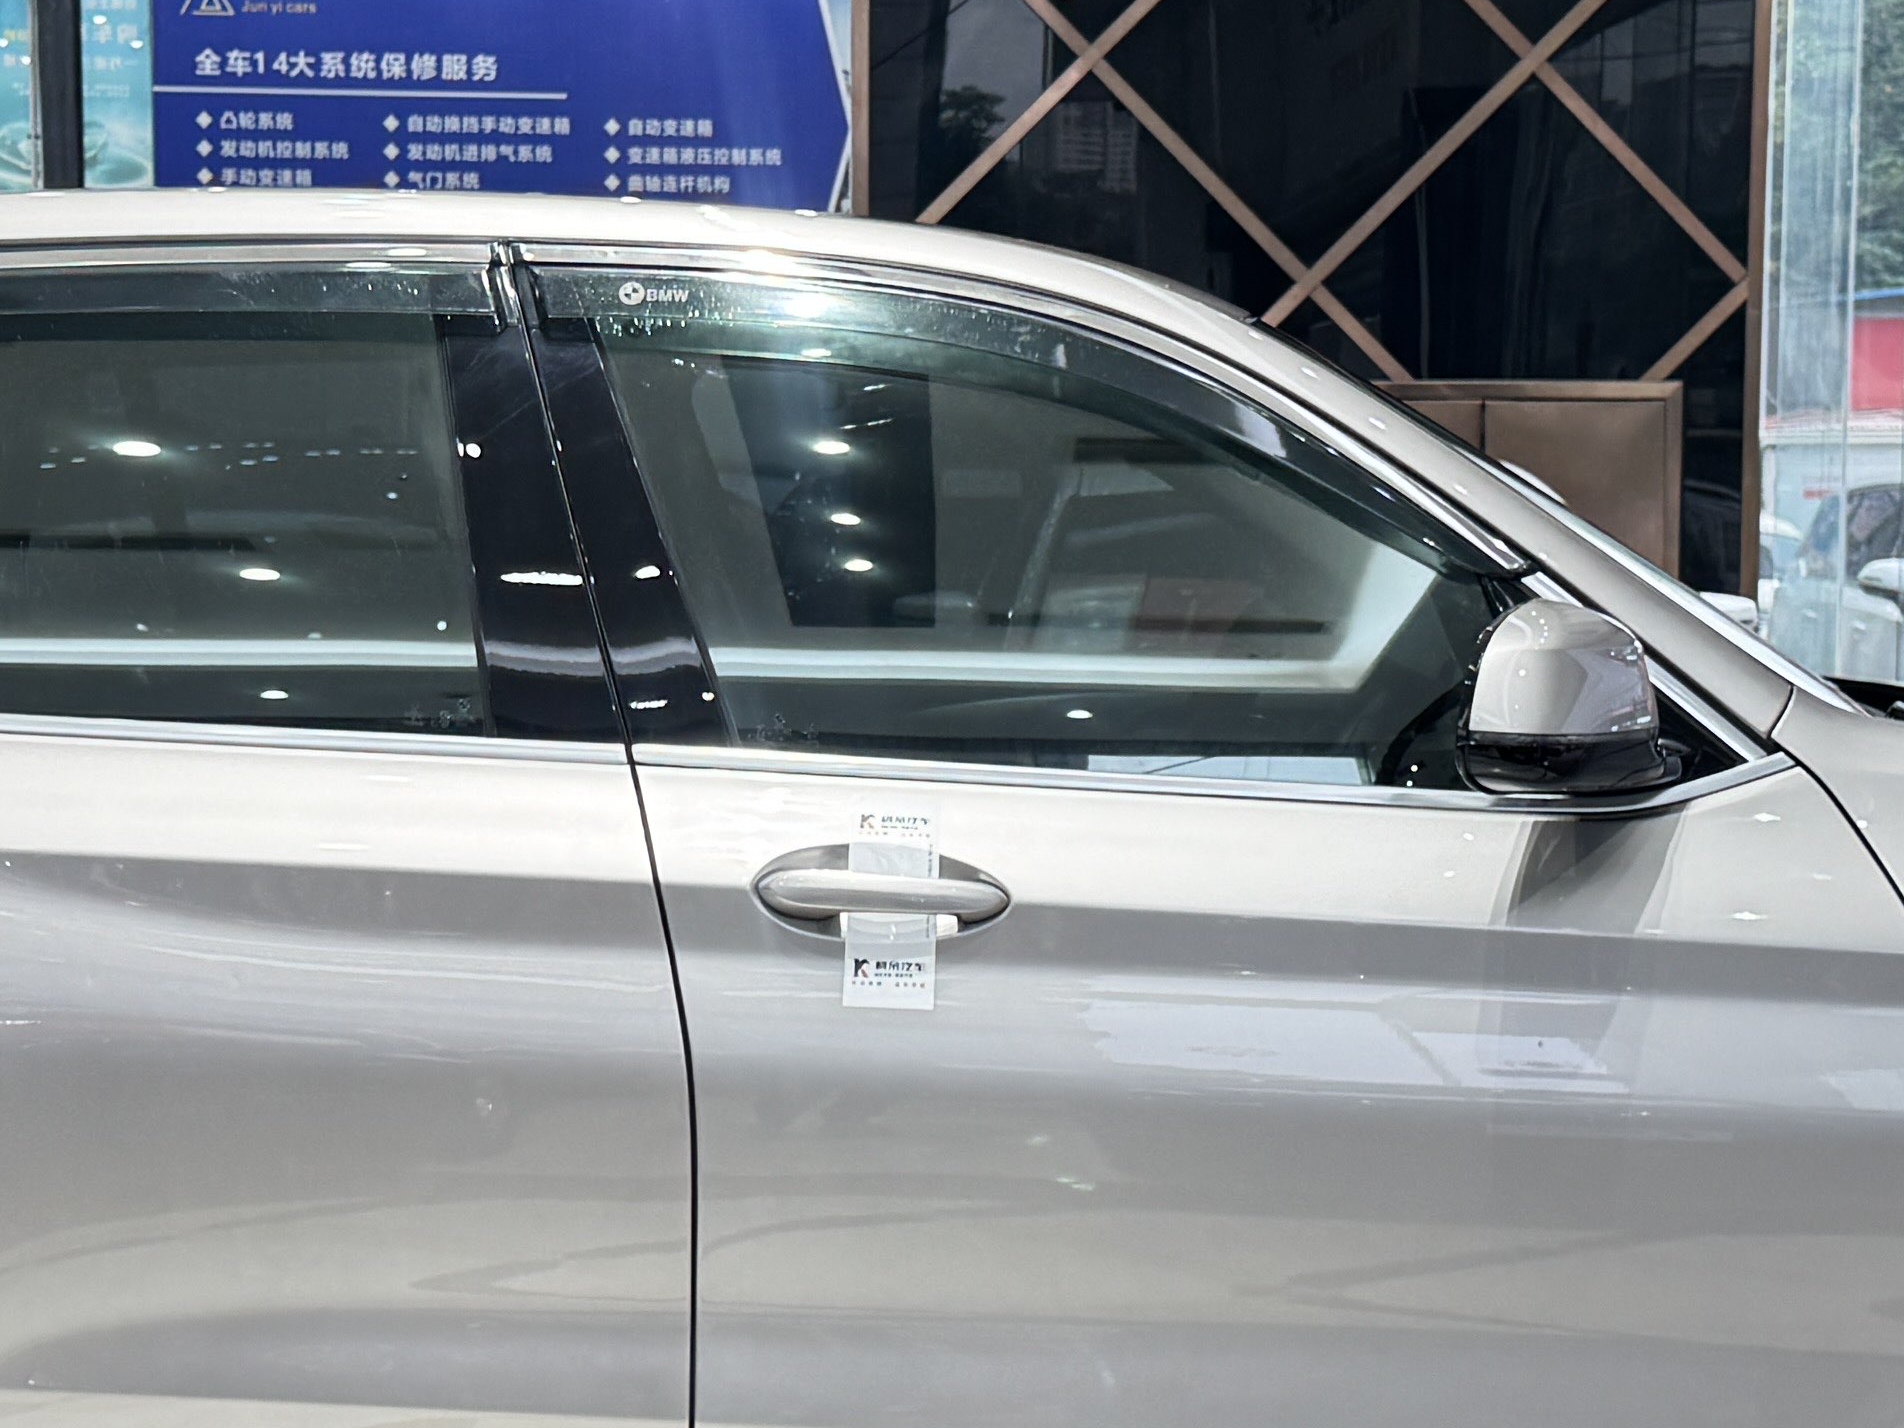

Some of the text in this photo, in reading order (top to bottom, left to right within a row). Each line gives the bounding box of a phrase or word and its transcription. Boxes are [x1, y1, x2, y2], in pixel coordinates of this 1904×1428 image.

[195, 47, 498, 82] 全车14大系统保修服务
[220, 111, 713, 137] 凸轮系统 自动换挡手动变速箱 自动变速箱
[220, 139, 783, 166] 发动机控制系统 发动机进排气系统 变速箱液压控制系统
[220, 167, 312, 187] 手动变速箱
[407, 170, 480, 190] 气门系统
[646, 288, 689, 303] BMW
